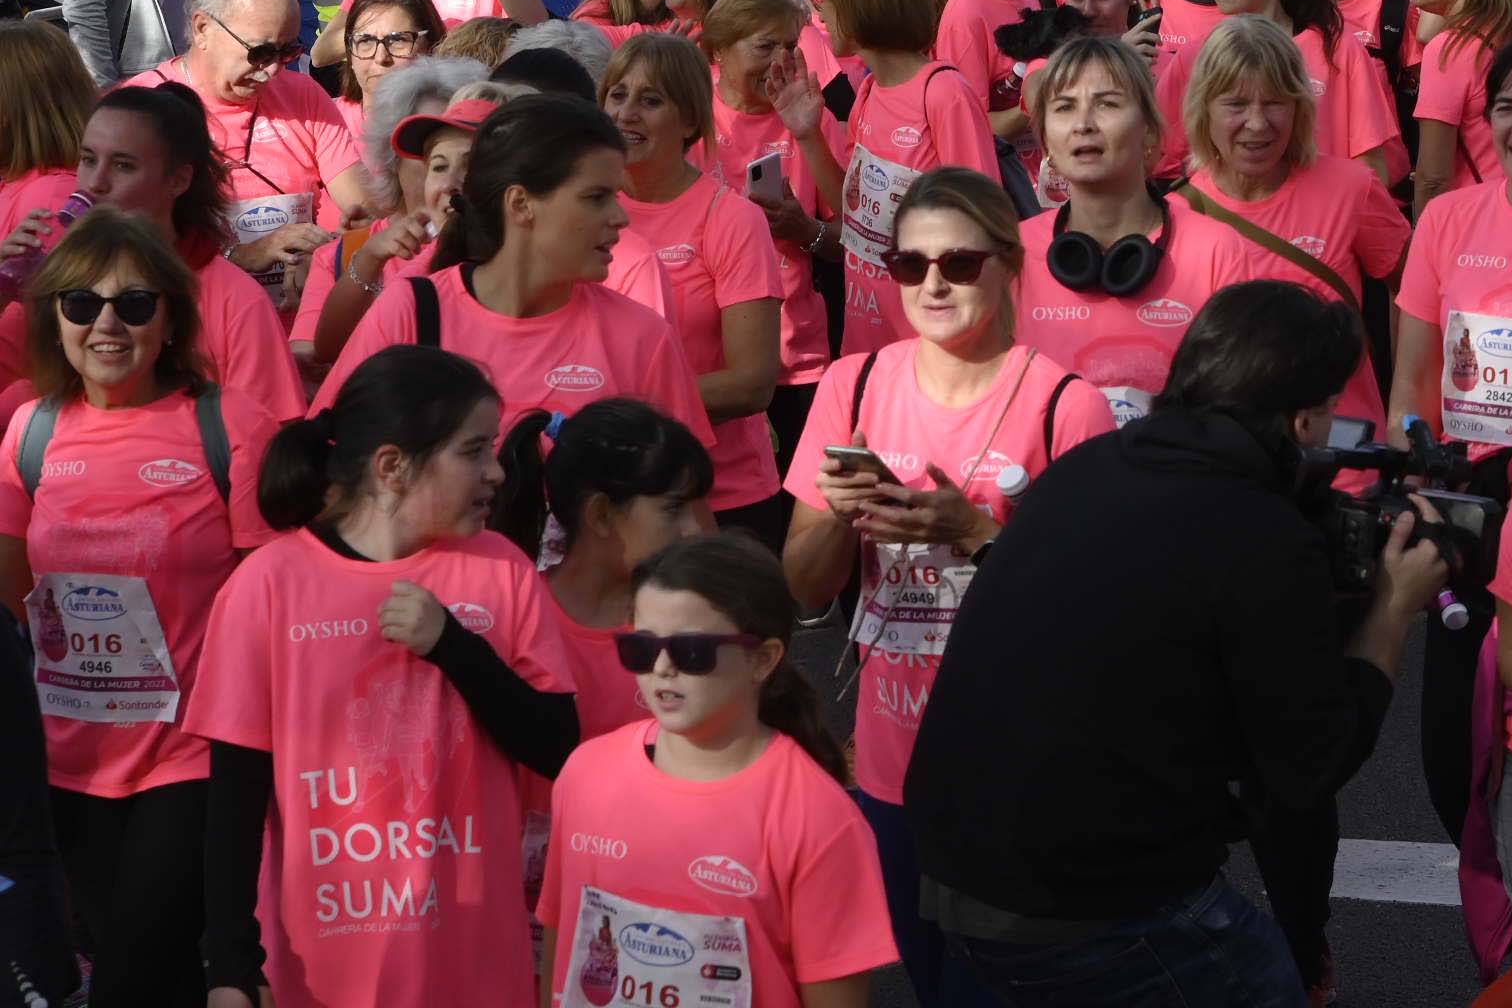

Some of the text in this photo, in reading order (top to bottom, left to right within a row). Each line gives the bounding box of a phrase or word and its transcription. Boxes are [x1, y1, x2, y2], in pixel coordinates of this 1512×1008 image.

[1158, 32, 1187, 45] YSHO
[861, 194, 881, 216] 016
[239, 213, 286, 229] ASTURIANA
[1457, 253, 1507, 269] OYSHO
[1032, 306, 1090, 321] OYSHO
[1140, 307, 1190, 322] ASTURIANA
[1487, 407, 1498, 416] DE
[1499, 408, 1508, 416] LA
[41, 459, 86, 478] OYSHO
[880, 450, 917, 470] SHO
[886, 565, 941, 586] 016
[66, 594, 125, 614] ASTURIANA
[290, 618, 368, 642] OYSHO
[71, 632, 122, 654] 016
[79, 659, 112, 674] 4946
[80, 679, 93, 688] DE
[94, 680, 105, 689] LA
[107, 679, 140, 690] MUJER
[46, 693, 169, 711] OYSHO Santander
[300, 767, 358, 809] TU
[309, 815, 482, 866] DORSAL
[571, 832, 628, 860] OYSHO
[316, 876, 440, 922] SUMA
[622, 932, 688, 961] ASTURIANA
[703, 941, 742, 953] SUMA
[621, 975, 680, 1008] 016
